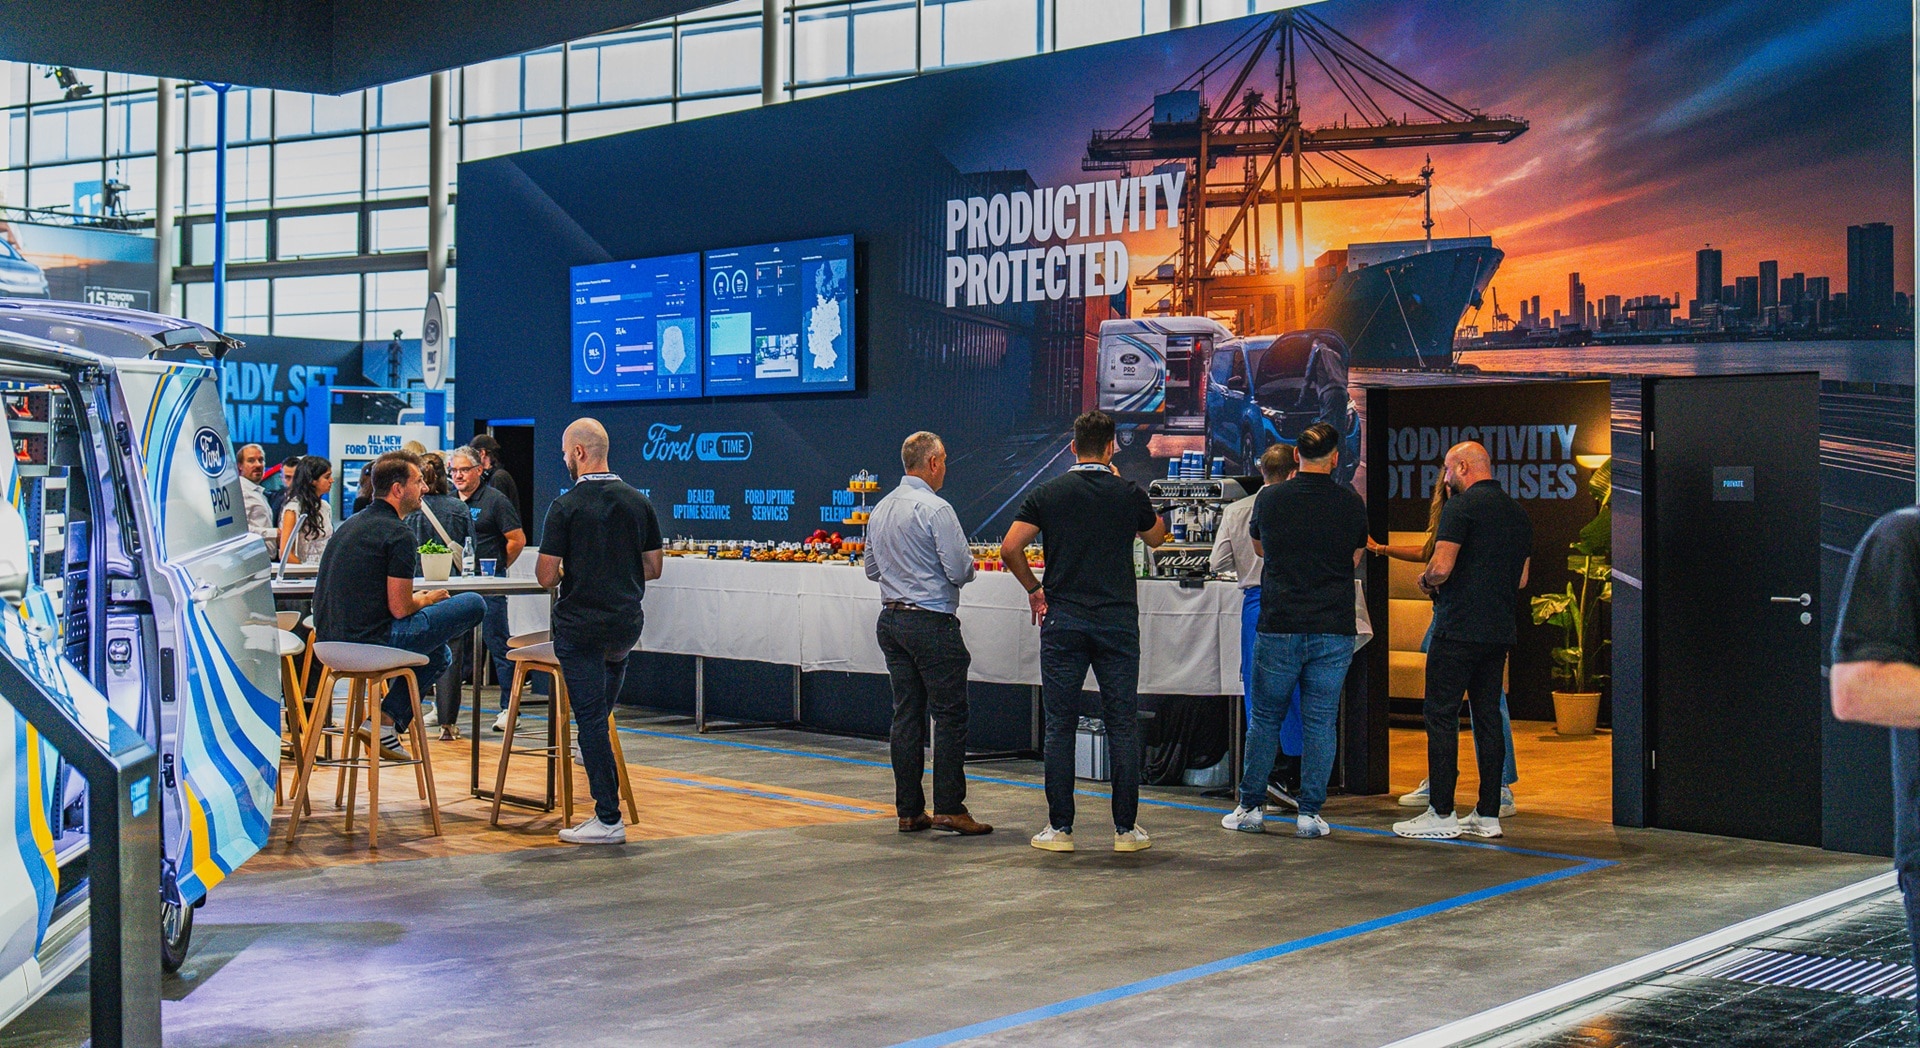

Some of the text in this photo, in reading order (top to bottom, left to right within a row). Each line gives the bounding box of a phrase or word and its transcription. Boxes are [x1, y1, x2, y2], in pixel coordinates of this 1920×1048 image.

[946, 171, 1186, 251] PRODUCTIVITY
[946, 240, 1129, 308] PROTECTED
[106, 292, 135, 302] TOYOTA
[367, 435, 402, 445] ALL-NEW
[642, 422, 745, 461] Ford UP TIME
[200, 435, 222, 469] Ford
[345, 445, 367, 455] FORD
[210, 486, 231, 513] PRO
[687, 489, 715, 504] DEALER
[744, 489, 795, 505] FORD UPTIME
[832, 490, 855, 505] FORD
[673, 505, 731, 520] UPTIME SERVICE
[752, 505, 789, 521] SERVICES
[820, 506, 858, 522] TELEMA
